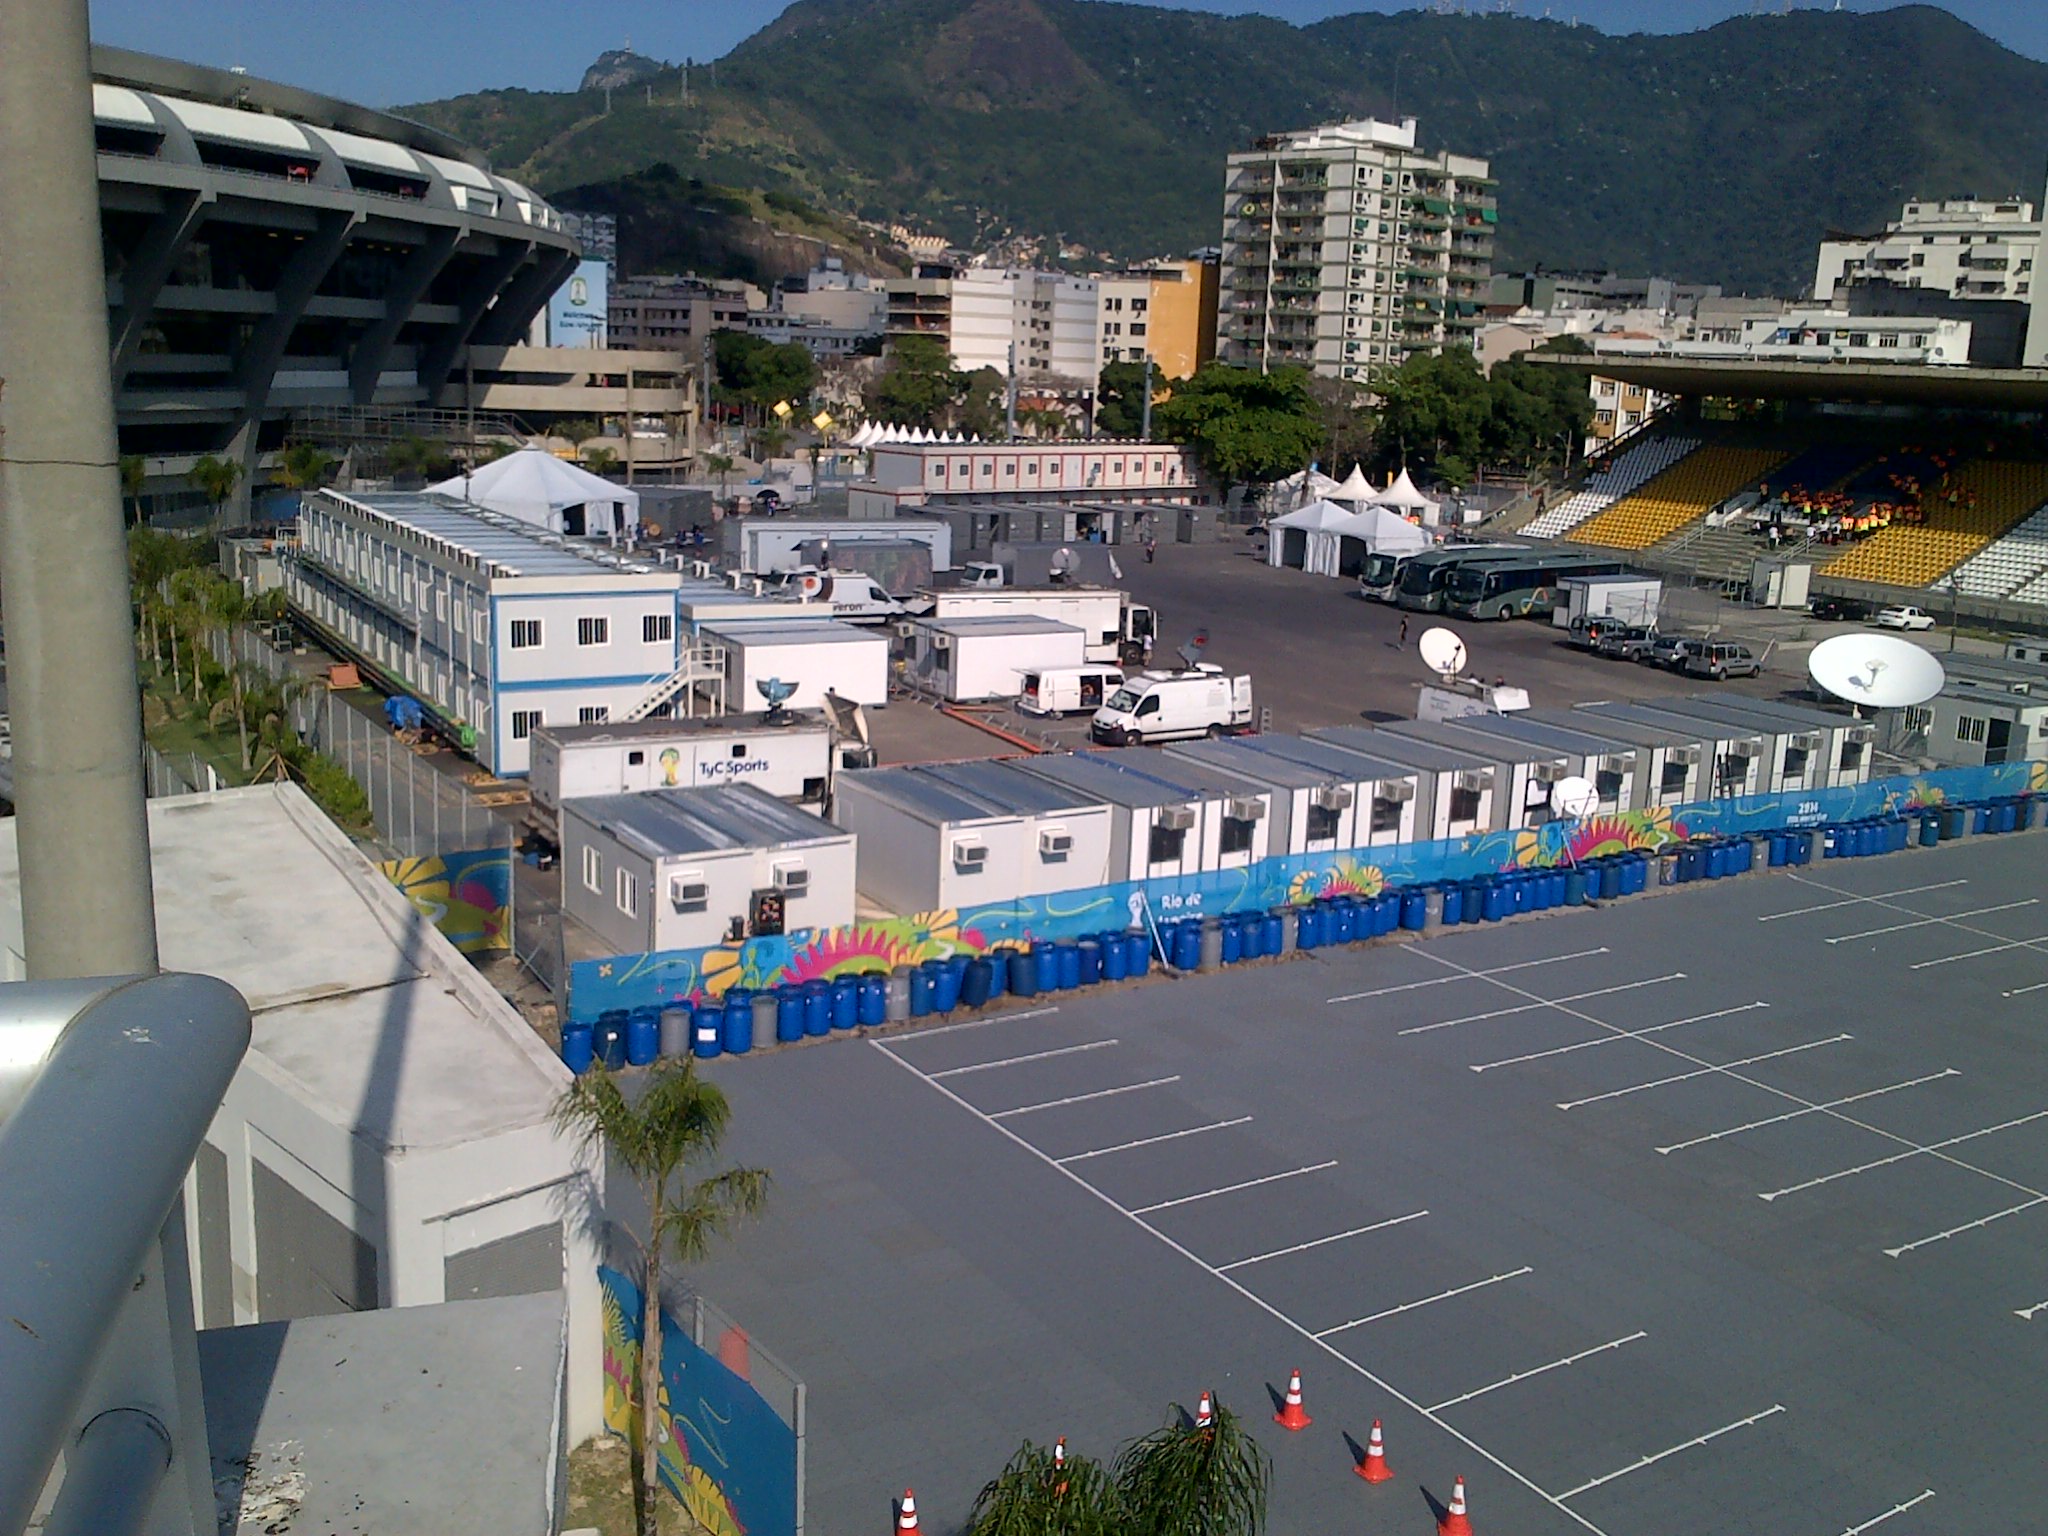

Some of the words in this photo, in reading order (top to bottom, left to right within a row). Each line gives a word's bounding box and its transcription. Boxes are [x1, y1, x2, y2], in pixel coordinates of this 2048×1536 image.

[700, 762, 724, 778] TyC
[726, 760, 769, 775] Sports
[1161, 893, 1183, 910] Rio
[1185, 892, 1202, 907] de
